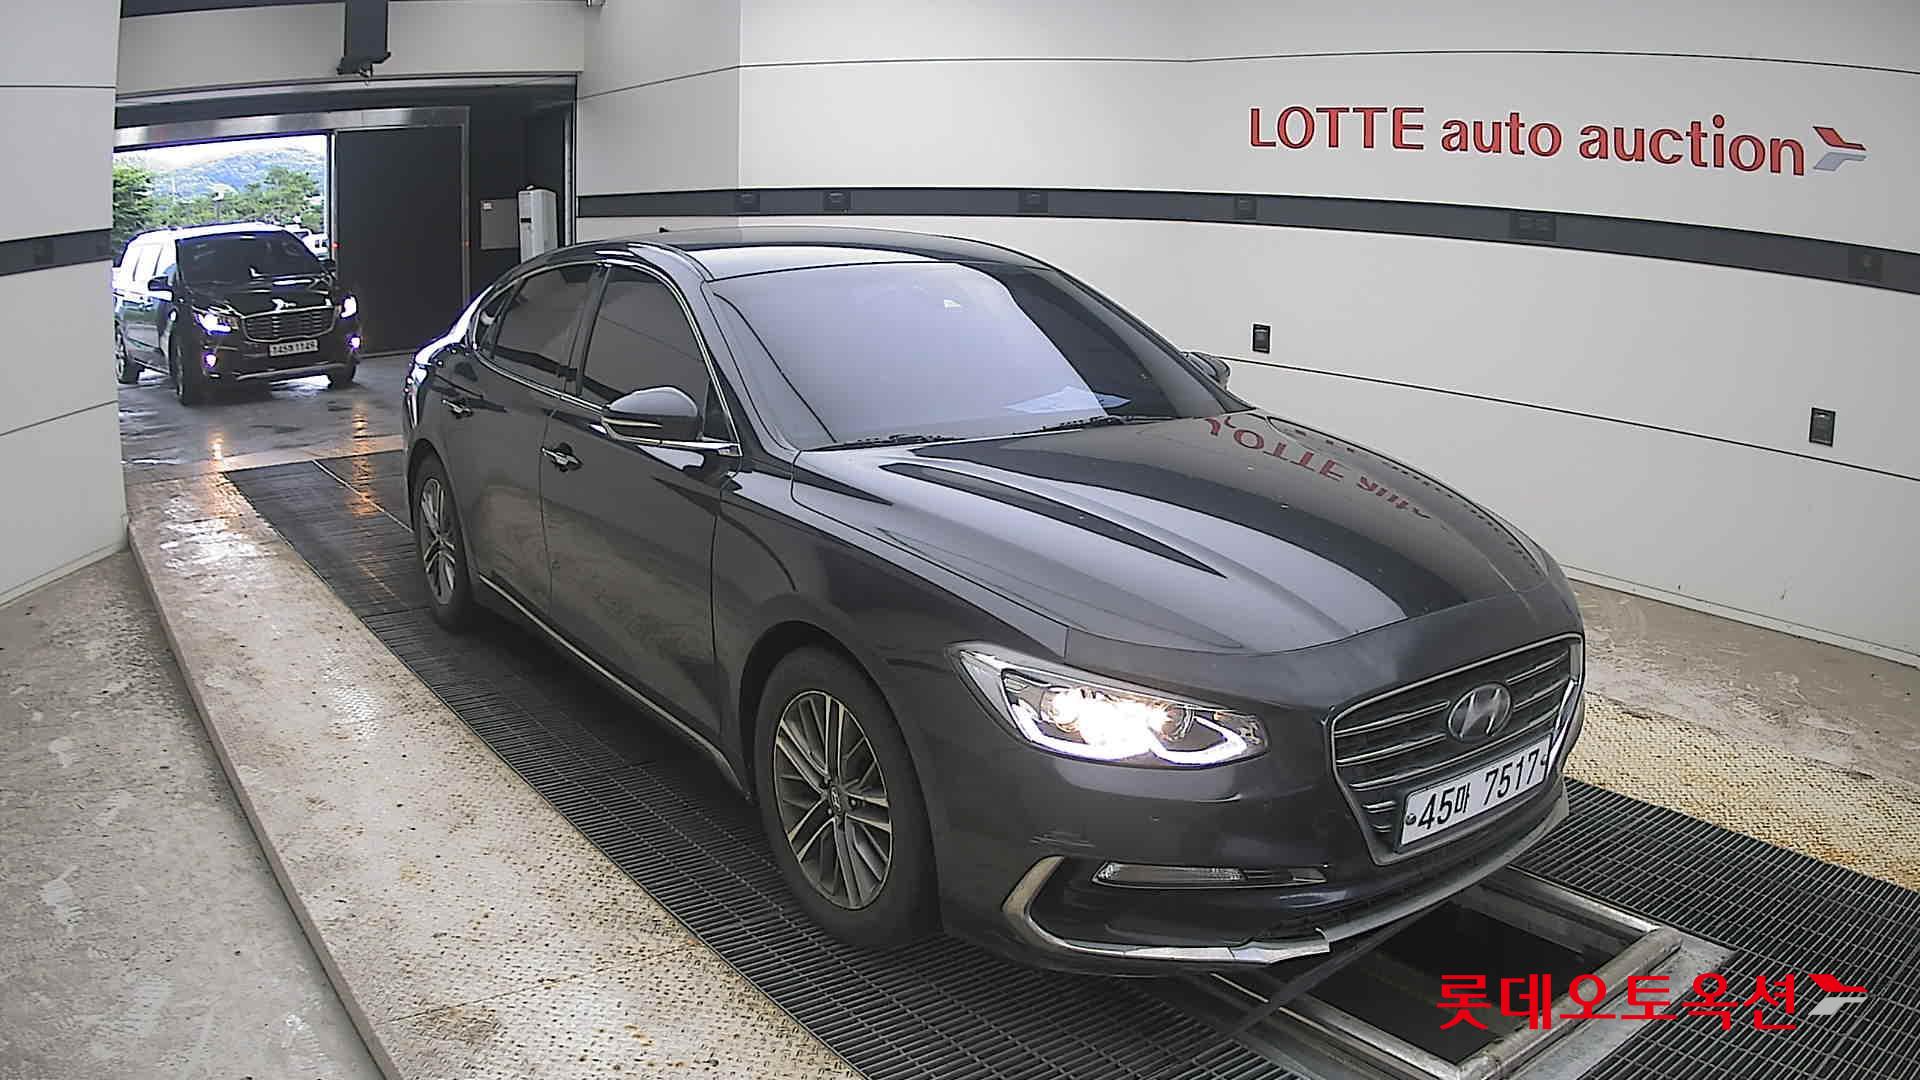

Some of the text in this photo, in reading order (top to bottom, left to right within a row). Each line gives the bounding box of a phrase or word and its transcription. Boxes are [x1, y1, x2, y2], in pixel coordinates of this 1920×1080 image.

[1249, 106, 1806, 177] LOTTE auto auction
[1417, 748, 1541, 830] 45마 7517
